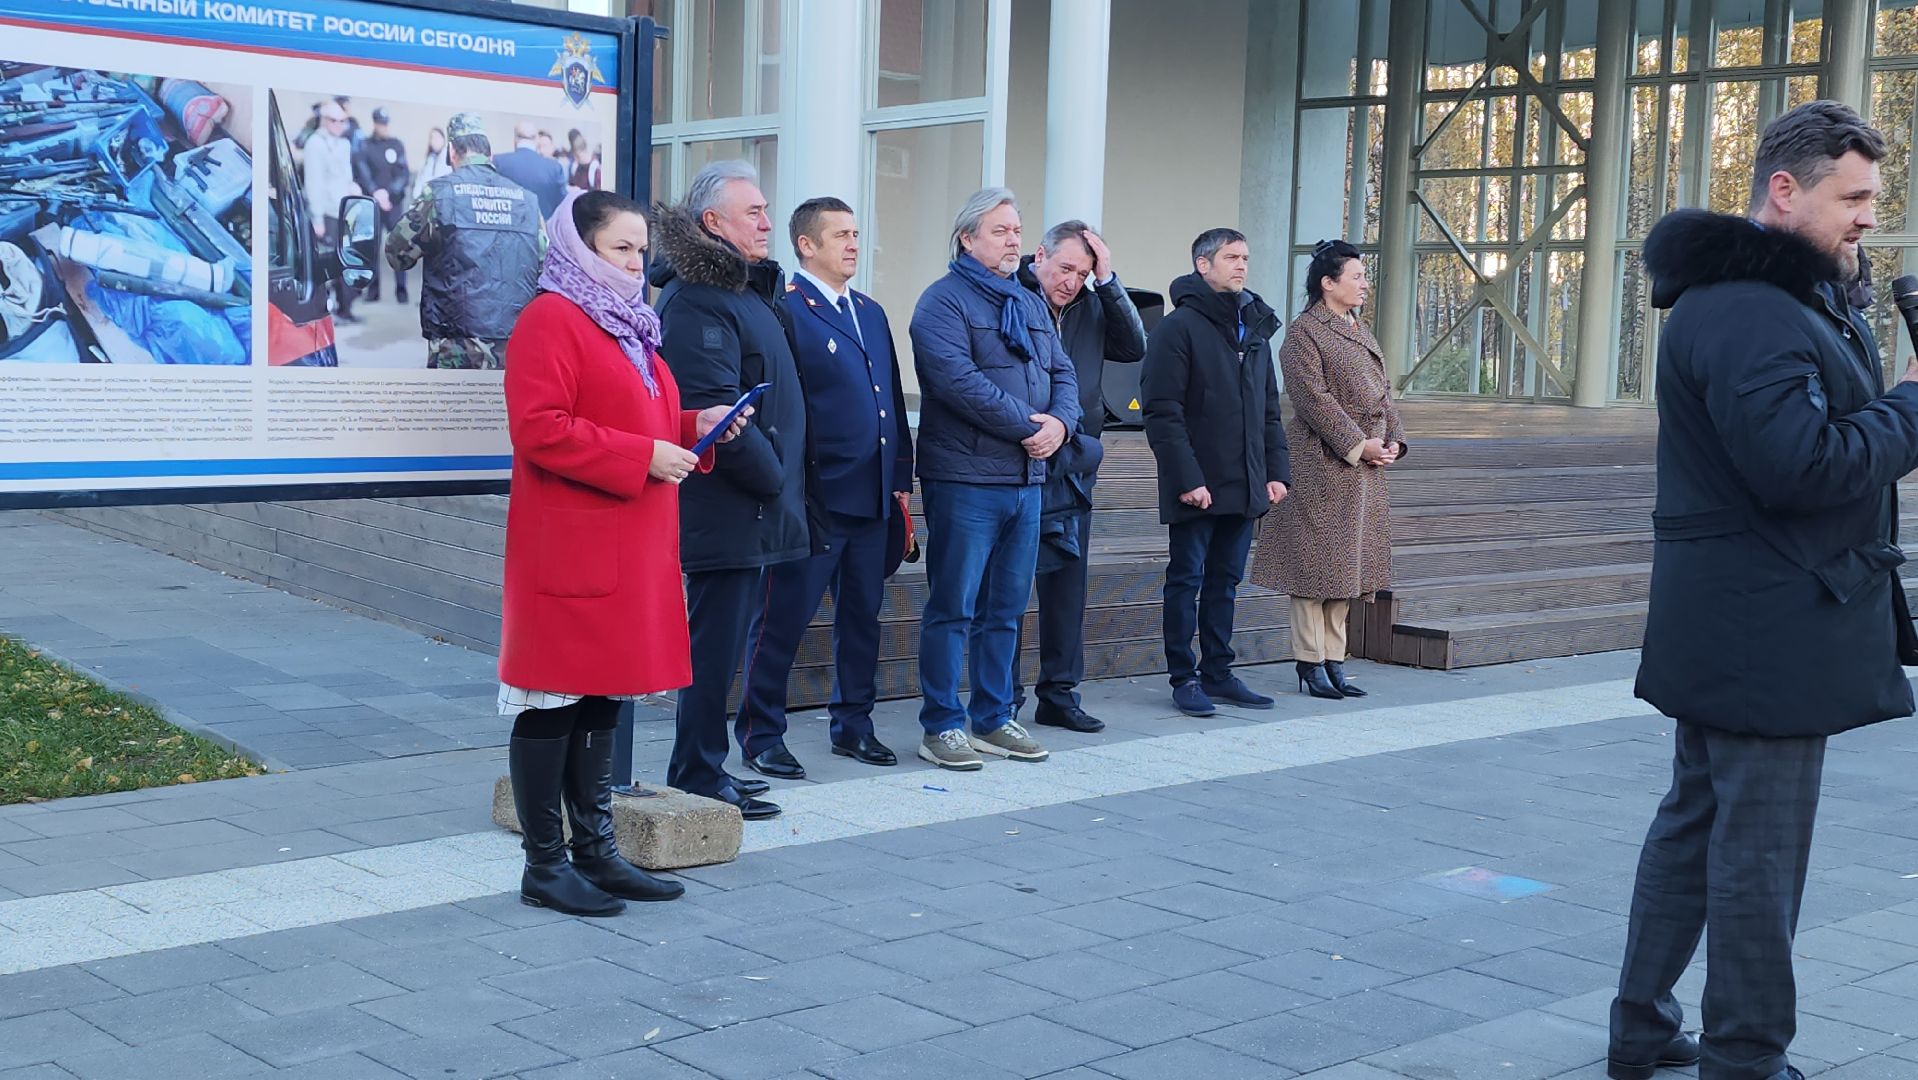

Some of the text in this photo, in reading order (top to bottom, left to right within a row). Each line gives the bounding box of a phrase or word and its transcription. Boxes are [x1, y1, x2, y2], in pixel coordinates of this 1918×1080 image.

[204, 1, 317, 32] КОМИТЕТ
[324, 17, 415, 44] РОССИИ
[421, 29, 516, 57] СЕГОДНЯ
[453, 183, 525, 200] СЛЕДСТВЕННЫЙ
[471, 198, 513, 212] КОМИТЕТ
[475, 211, 512, 225] РОССИИ
